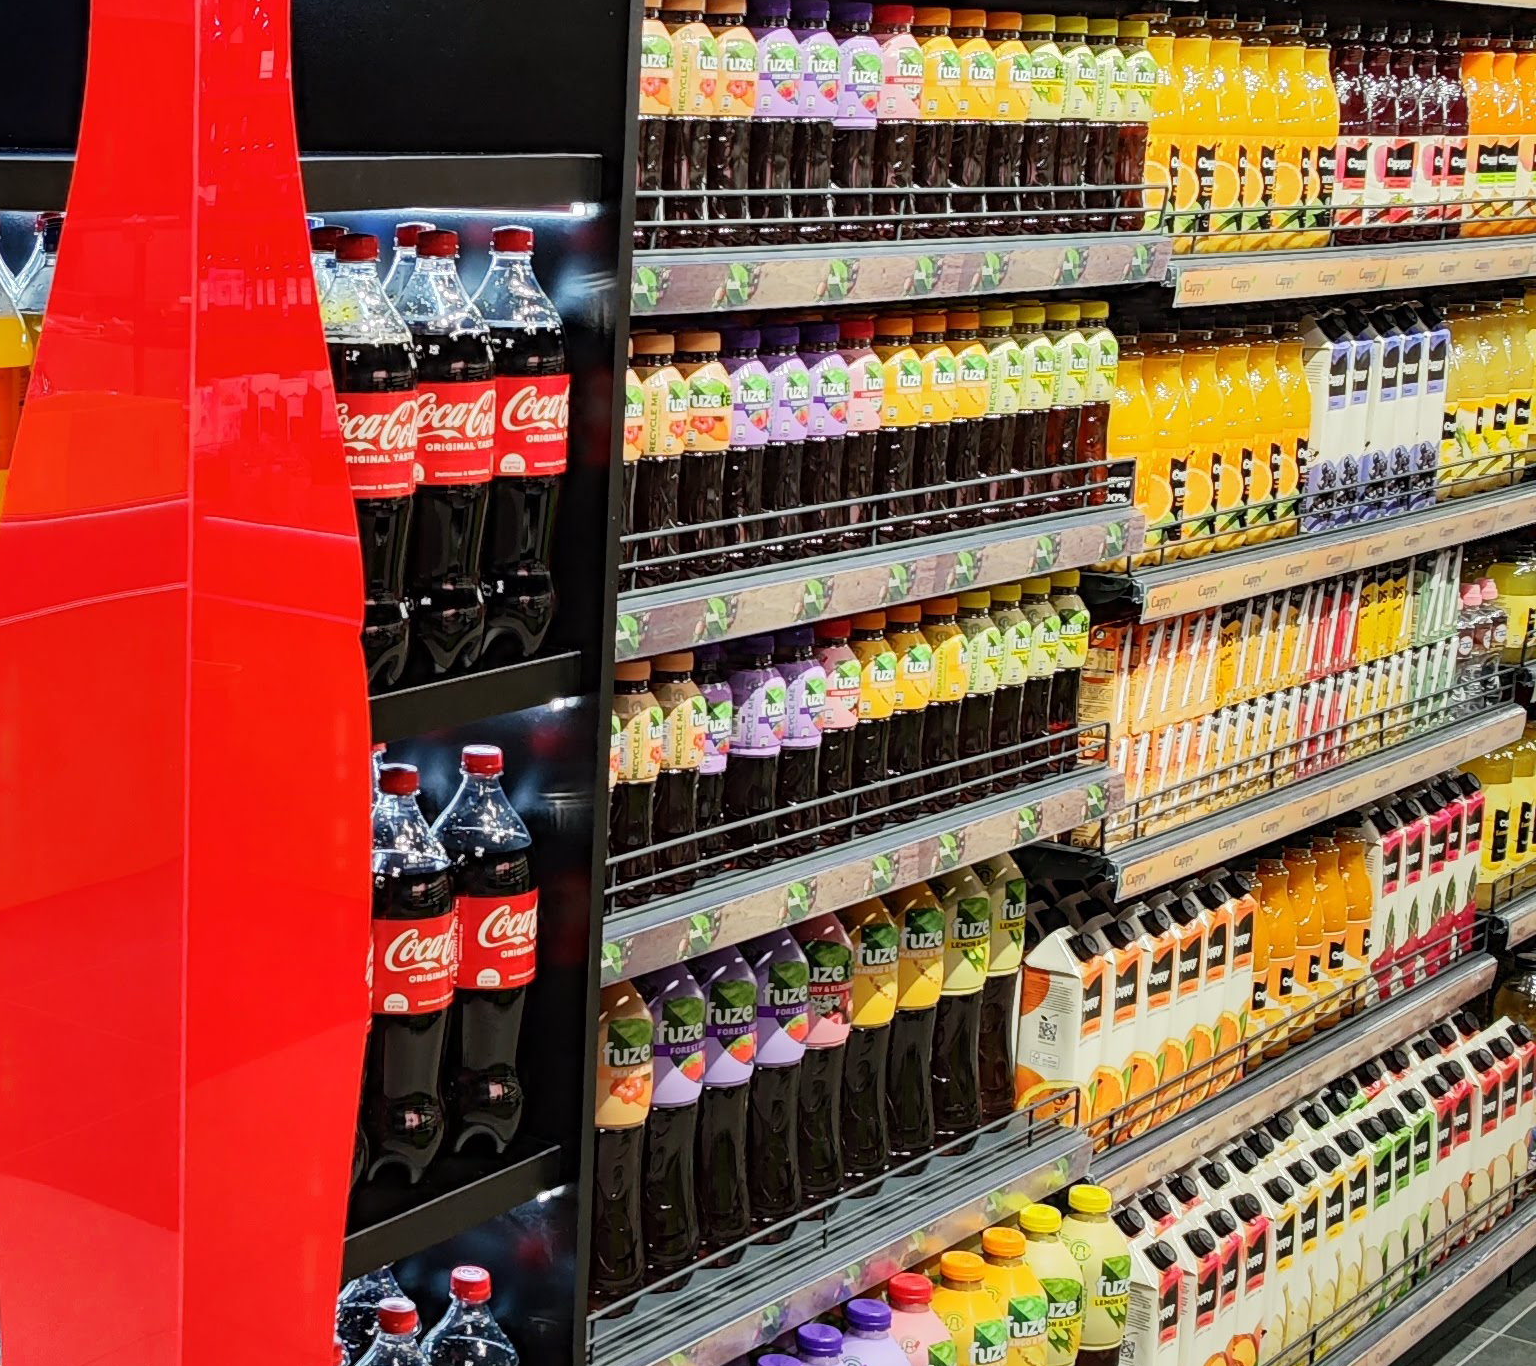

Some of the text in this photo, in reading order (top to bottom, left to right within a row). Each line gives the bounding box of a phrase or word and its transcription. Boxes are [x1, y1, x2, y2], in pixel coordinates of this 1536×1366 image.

[722, 52, 753, 72] fuze
[763, 54, 794, 73] fuze
[806, 54, 835, 73] fuze
[896, 59, 923, 77] fuze
[848, 66, 879, 85] fuze
[960, 363, 986, 381] fuze
[737, 386, 765, 402] fuze
[816, 378, 844, 395] fuze
[425, 441, 476, 452] ORIGINAL
[345, 452, 391, 464] RIGINAL
[1242, 573, 1263, 587] Cappy
[1198, 584, 1219, 598] Cappy
[1151, 595, 1173, 610] Cappy
[833, 673, 859, 689] fuze
[1218, 836, 1239, 851] Cappy
[1173, 853, 1195, 868] Cappy
[1125, 871, 1148, 886] Cappy
[1001, 898, 1026, 920] fuz
[952, 917, 990, 939] fuze
[900, 926, 943, 949] fuze
[950, 940, 977, 949] LEMON
[855, 942, 898, 965] fuze
[408, 969, 449, 984] ORIGINAL
[809, 965, 844, 983] uze
[763, 983, 808, 1007] fuze
[706, 1002, 754, 1025] fuze
[656, 1020, 704, 1044] fuze
[716, 1026, 746, 1036] FOREST
[603, 1041, 651, 1066] fuze
[1049, 1301, 1077, 1319] uze
[1095, 1298, 1117, 1308] LEMON
[1006, 1315, 1047, 1339] fuze
[968, 1341, 1007, 1364] fuze
